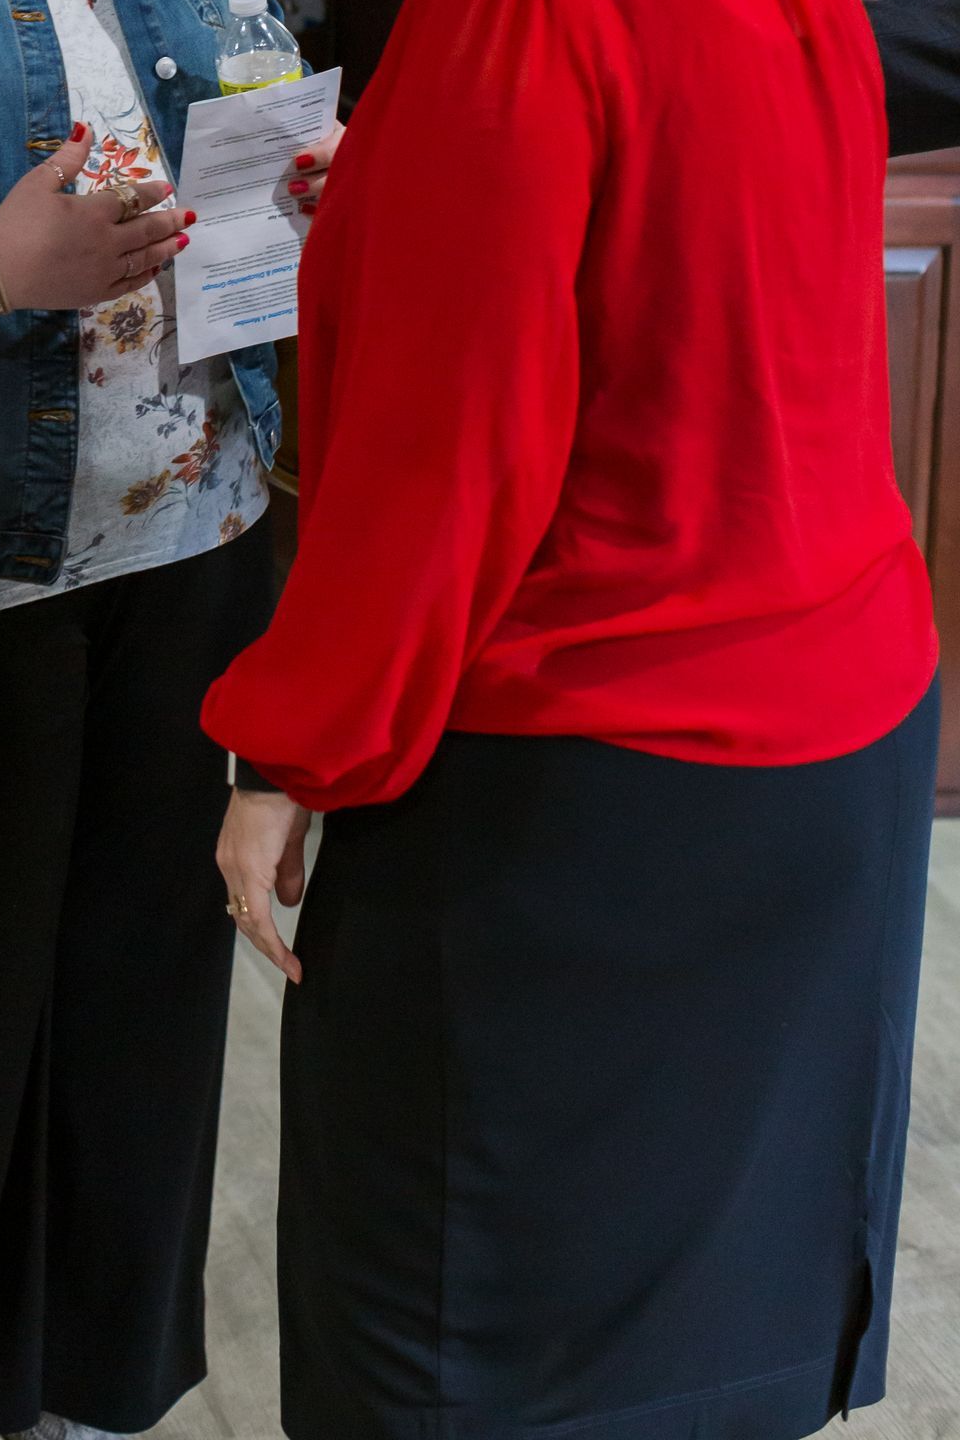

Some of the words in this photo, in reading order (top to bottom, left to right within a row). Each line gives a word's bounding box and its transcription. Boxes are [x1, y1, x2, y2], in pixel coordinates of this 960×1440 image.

[272, 264, 293, 275] School
[202, 281, 226, 291] Groups
[268, 308, 293, 319] Become
[233, 317, 261, 327] Member
